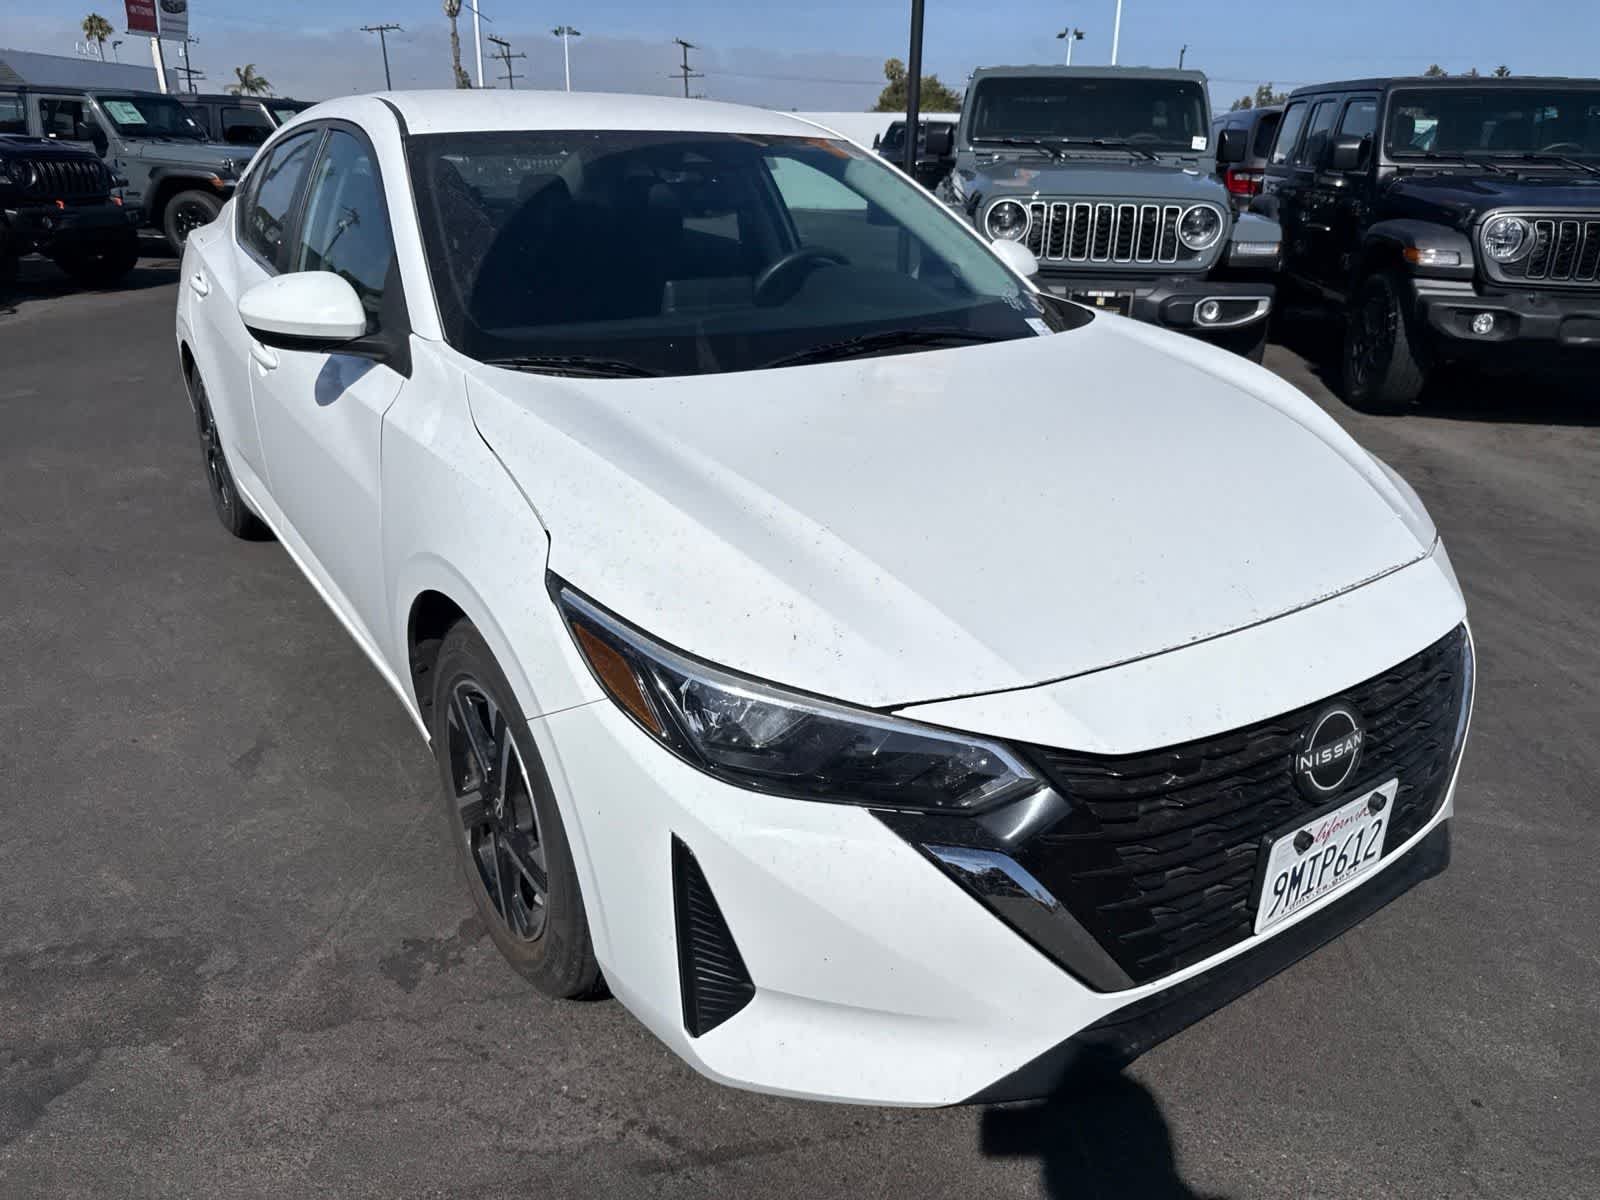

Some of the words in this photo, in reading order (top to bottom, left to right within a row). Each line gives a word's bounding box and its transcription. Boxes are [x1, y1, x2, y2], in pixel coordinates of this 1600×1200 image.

[1300, 731, 1362, 770] NISSAN
[1307, 806, 1370, 845] lifornia
[1267, 818, 1382, 918] 9MIP612
